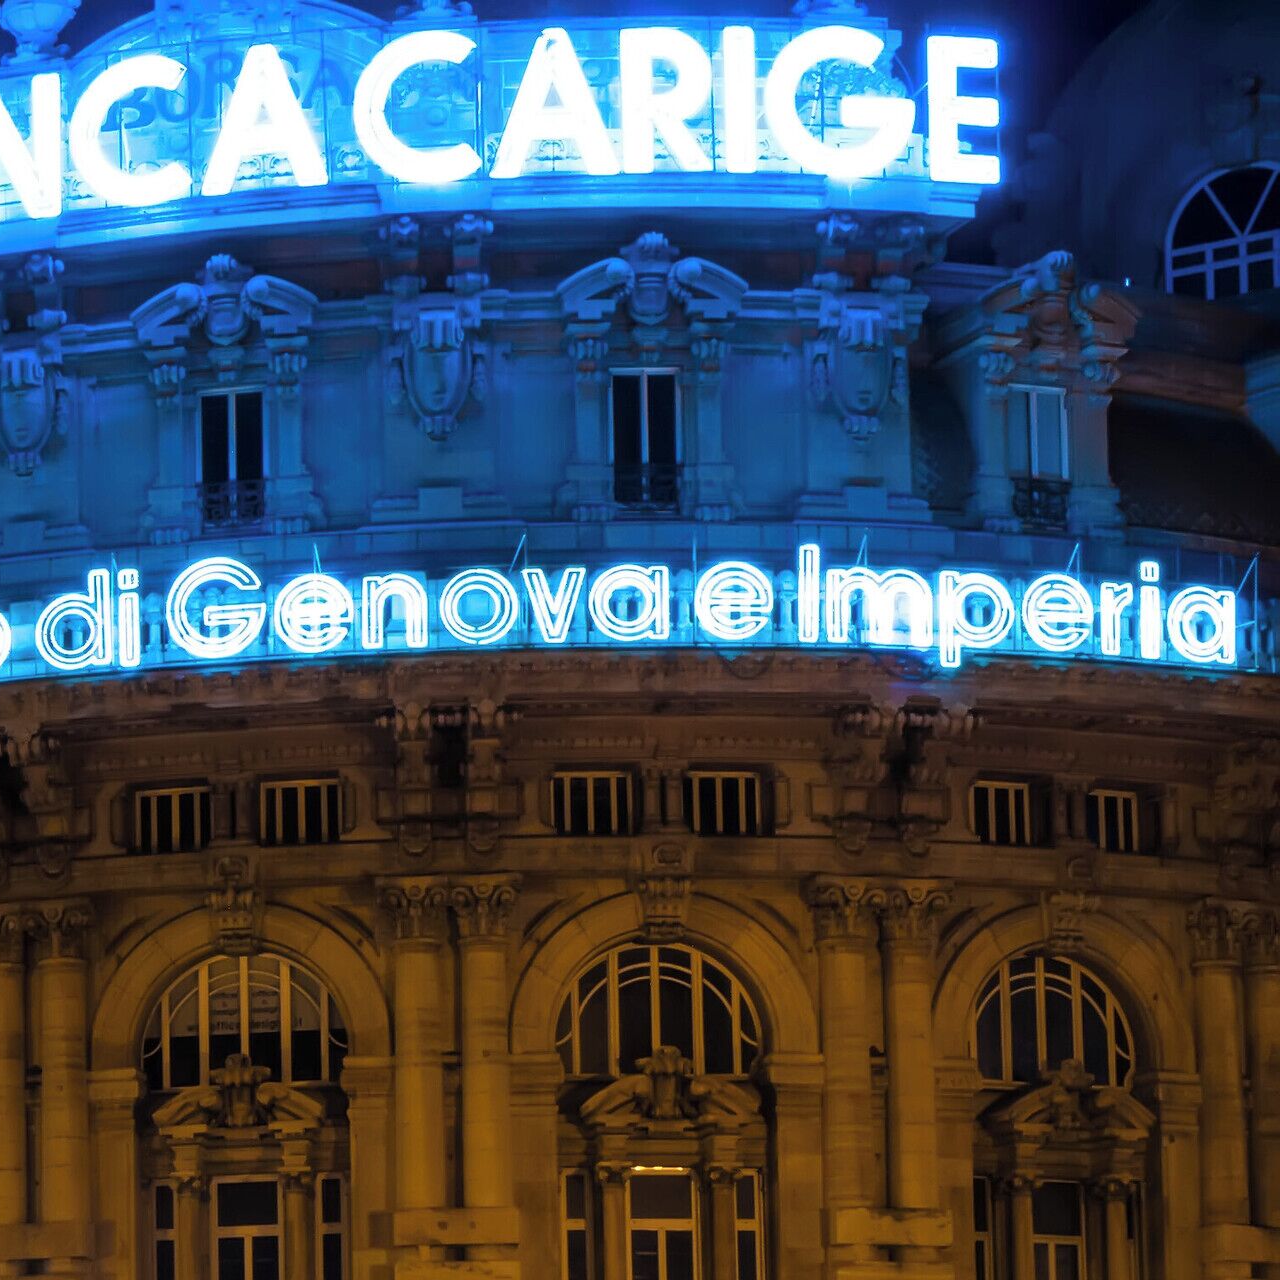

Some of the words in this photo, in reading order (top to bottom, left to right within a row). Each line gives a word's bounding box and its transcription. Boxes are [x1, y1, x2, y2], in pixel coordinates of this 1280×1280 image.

[351, 24, 1001, 185] CARIGE
[35, 567, 142, 672] di
[165, 556, 671, 659] Genova
[694, 560, 775, 641] e
[797, 543, 1237, 668] Imperia
